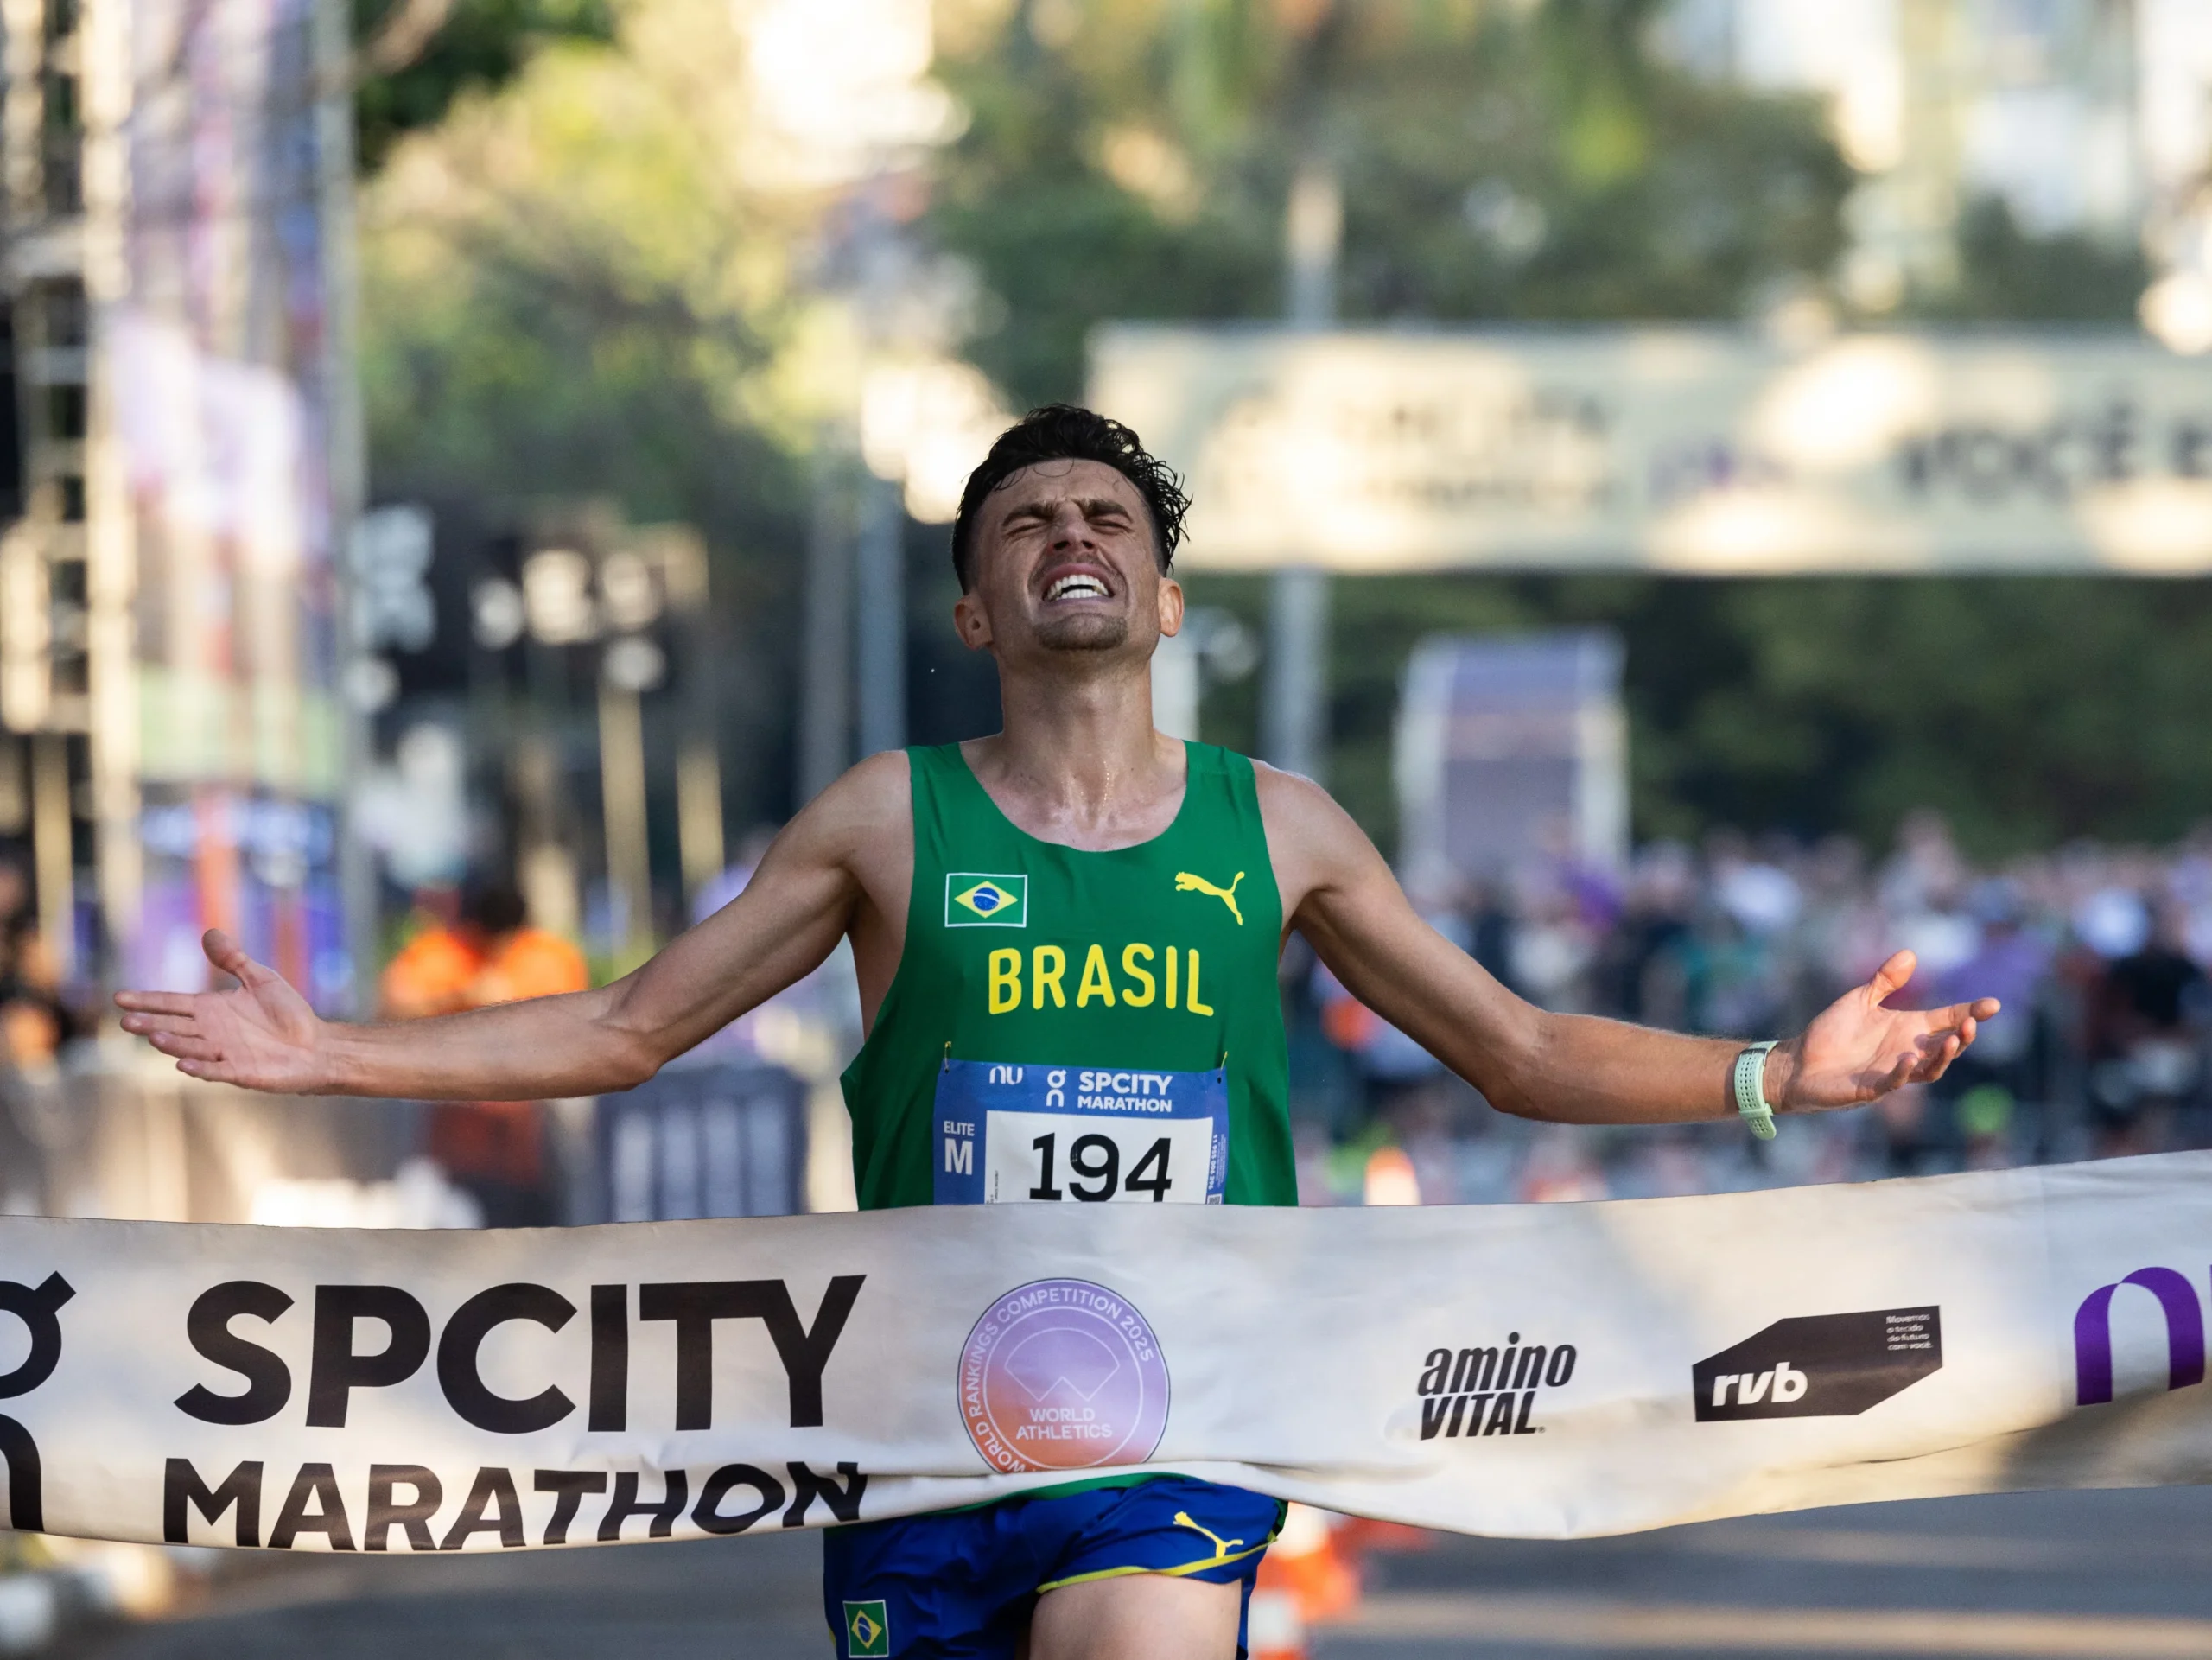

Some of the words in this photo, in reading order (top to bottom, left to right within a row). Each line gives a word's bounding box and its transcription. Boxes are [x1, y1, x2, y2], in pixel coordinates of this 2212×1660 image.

[989, 943, 1214, 1017] BRASIL
[1077, 1095, 1173, 1113] MARATHON
[1078, 1071, 1173, 1096] SPCITY
[944, 1120, 975, 1137] ELITE
[944, 1138, 973, 1176] M
[1029, 1132, 1173, 1203] 194
[996, 1288, 1122, 1324] COMPETITION
[173, 1274, 868, 1434] SPCITY
[1120, 1314, 1154, 1362] 2025
[966, 1322, 999, 1417] RANKINGS
[1418, 1332, 1577, 1396] amino
[1712, 1361, 1808, 1407] rvb
[1016, 1424, 1113, 1441] ATHLETICS
[1030, 1408, 1096, 1422] WORLD
[976, 1421, 1027, 1472] WORLD
[163, 1457, 869, 1552] MARATHON
